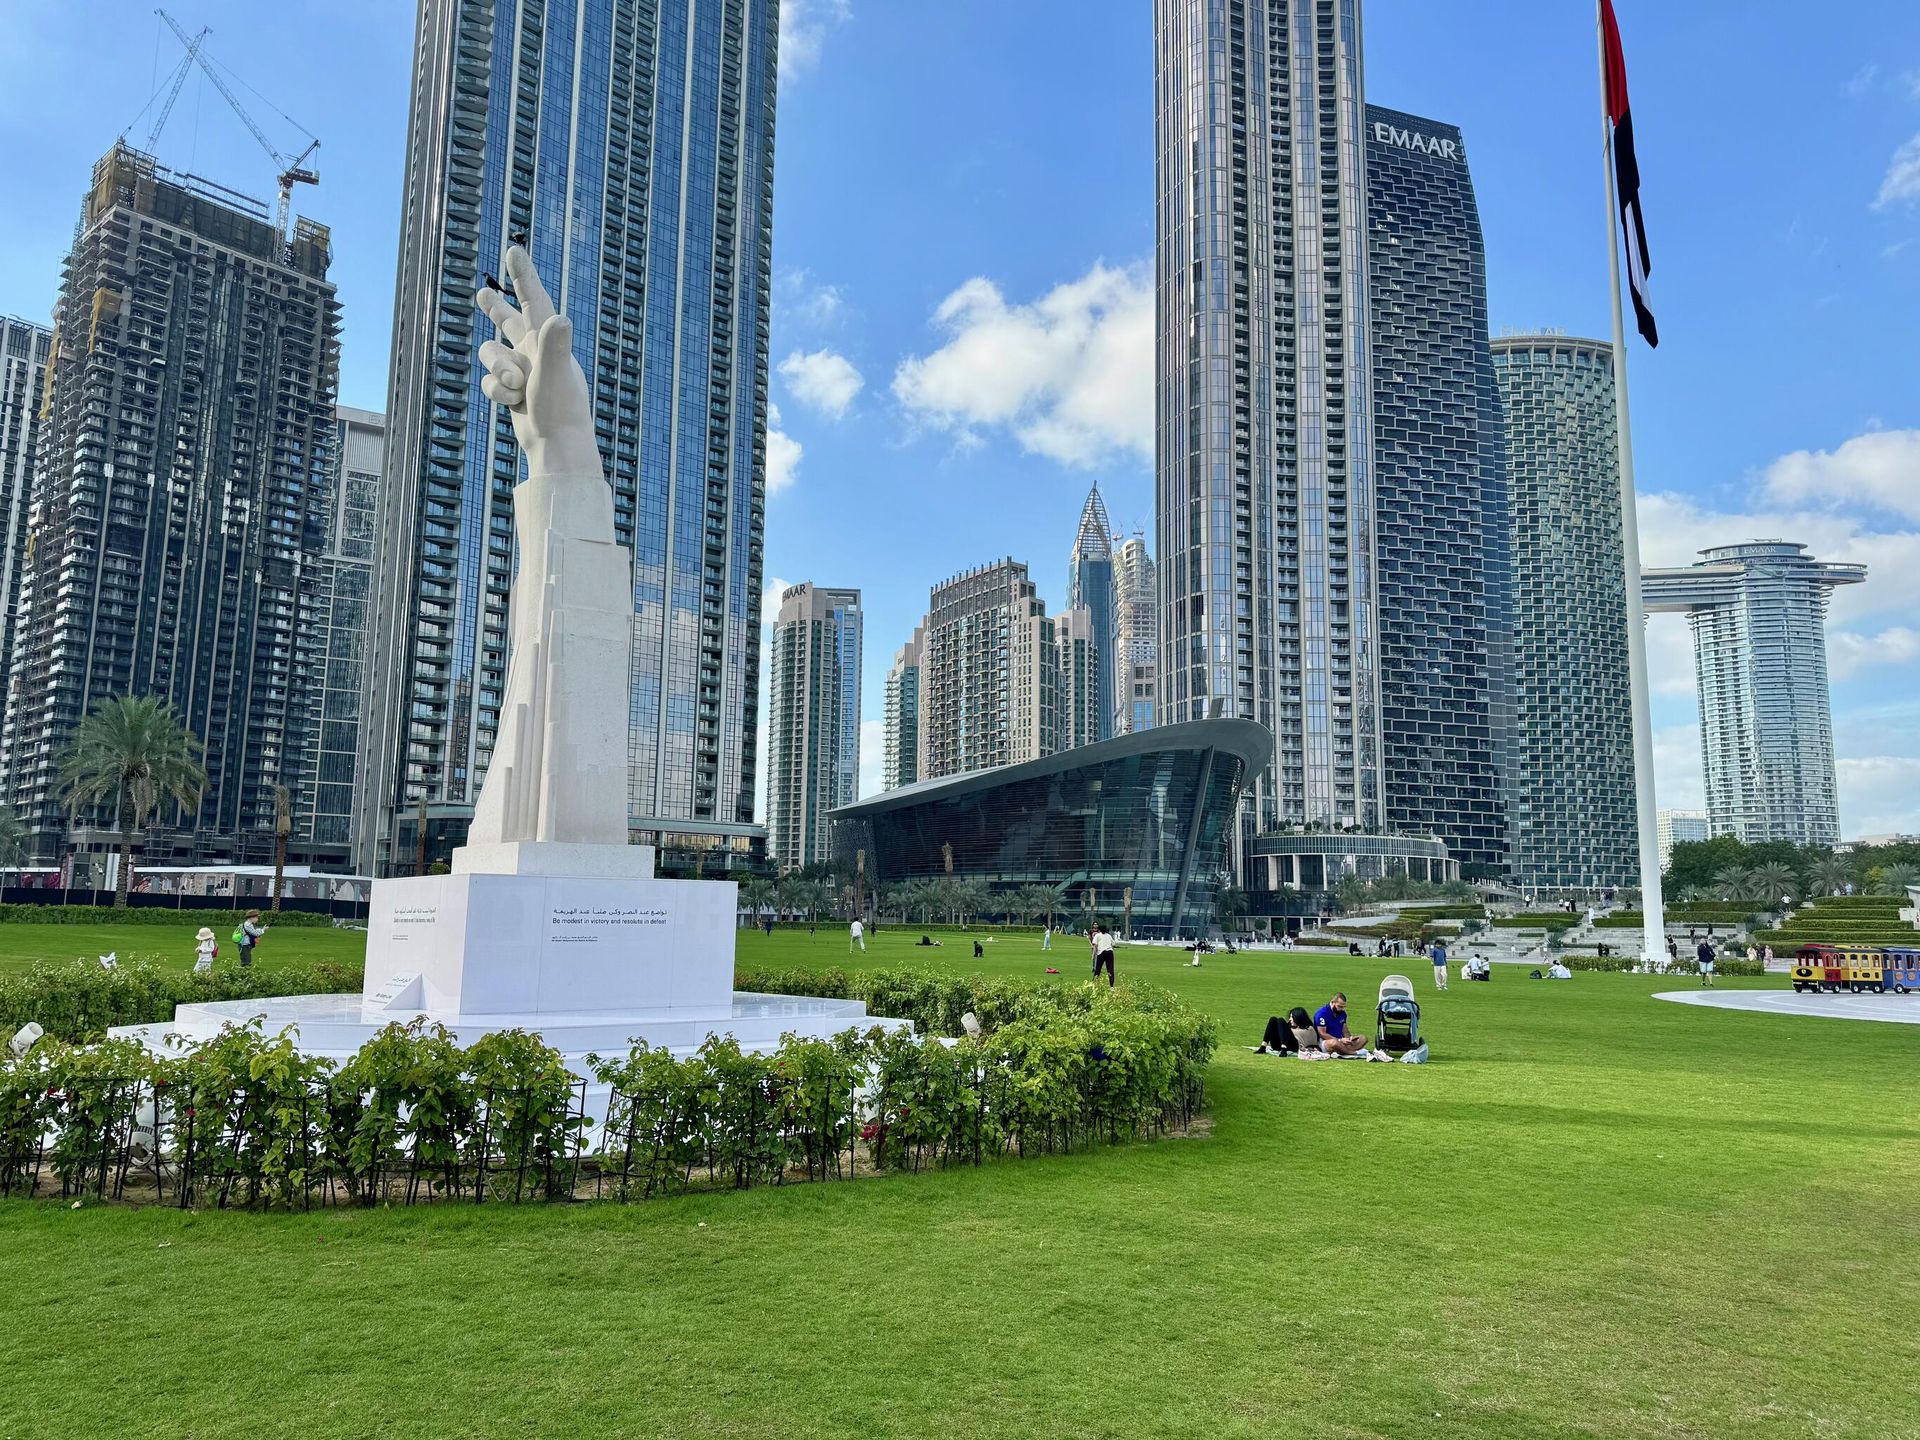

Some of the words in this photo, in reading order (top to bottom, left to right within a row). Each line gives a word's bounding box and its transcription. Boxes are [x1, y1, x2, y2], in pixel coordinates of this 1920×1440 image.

[1373, 121, 1458, 160] EMAAR
[1743, 545, 1777, 554] EMAAR
[1319, 1017, 1326, 1026] 3
